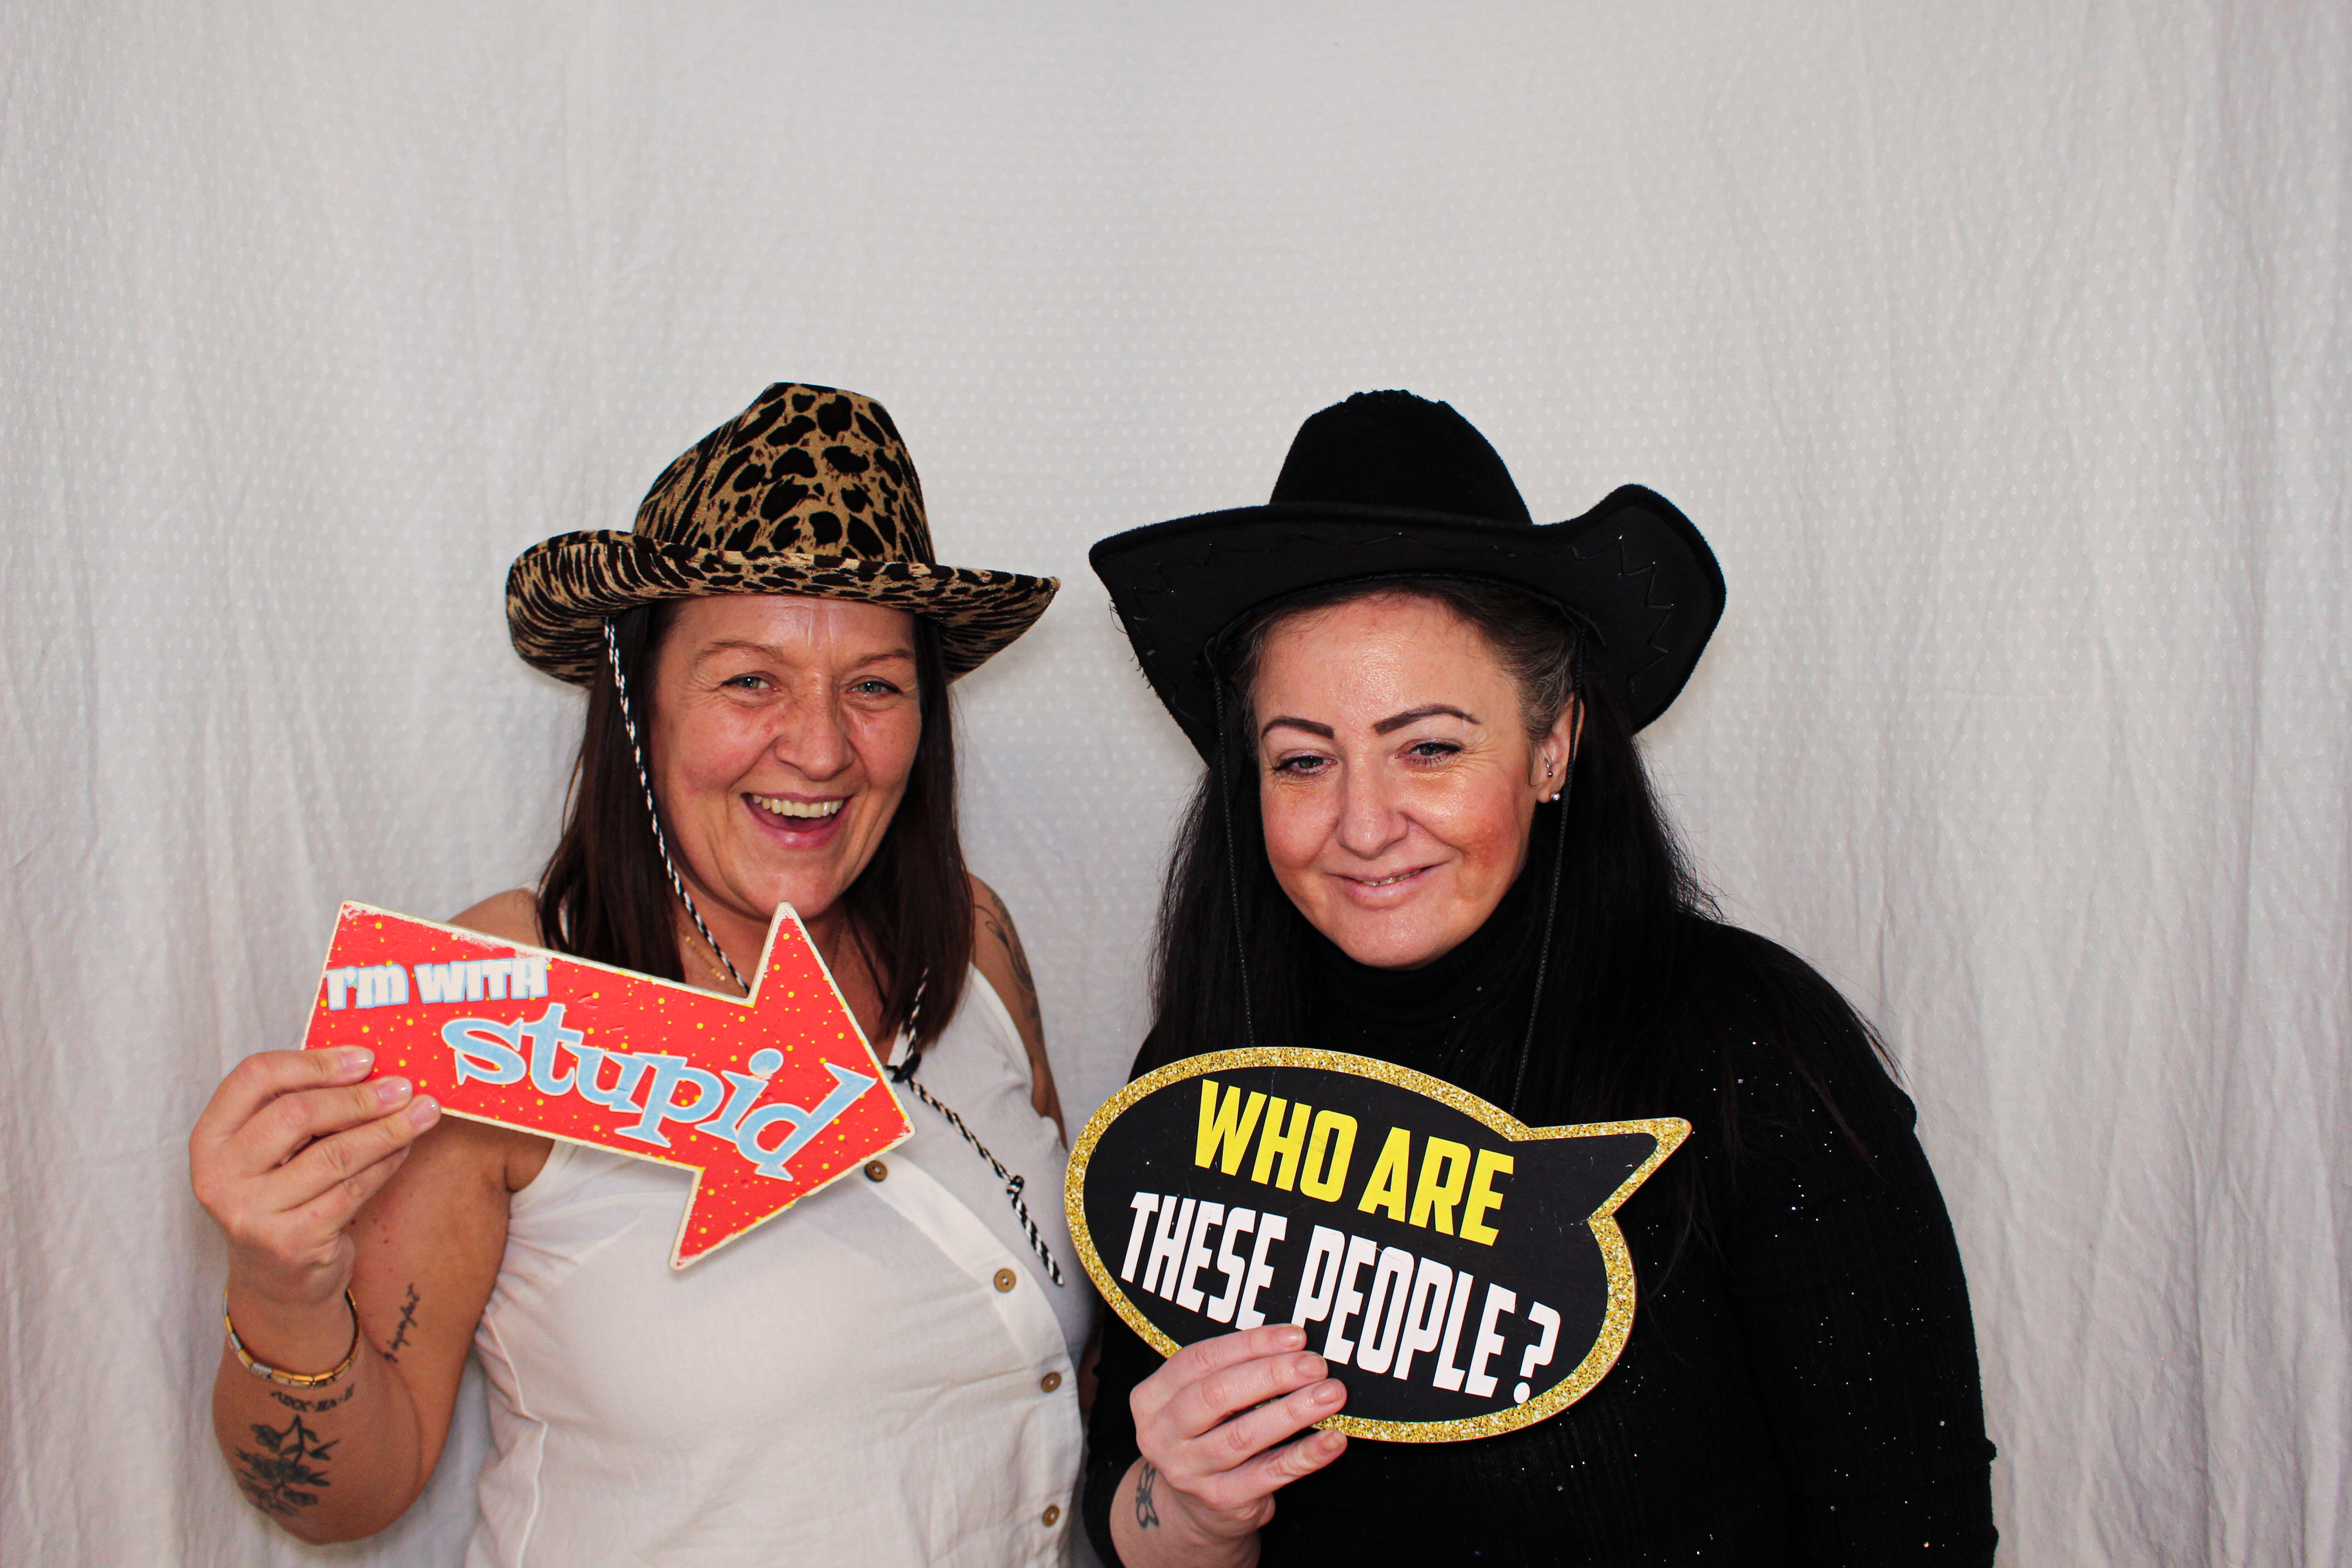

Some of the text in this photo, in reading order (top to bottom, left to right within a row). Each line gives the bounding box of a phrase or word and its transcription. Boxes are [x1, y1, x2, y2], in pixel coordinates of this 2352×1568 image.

[413, 957, 548, 1004] WITH
[441, 1003, 877, 1181] stupid
[1195, 1079, 1514, 1246] WHO ARE
[1120, 1191, 1561, 1404] THESE PEOPLE?
